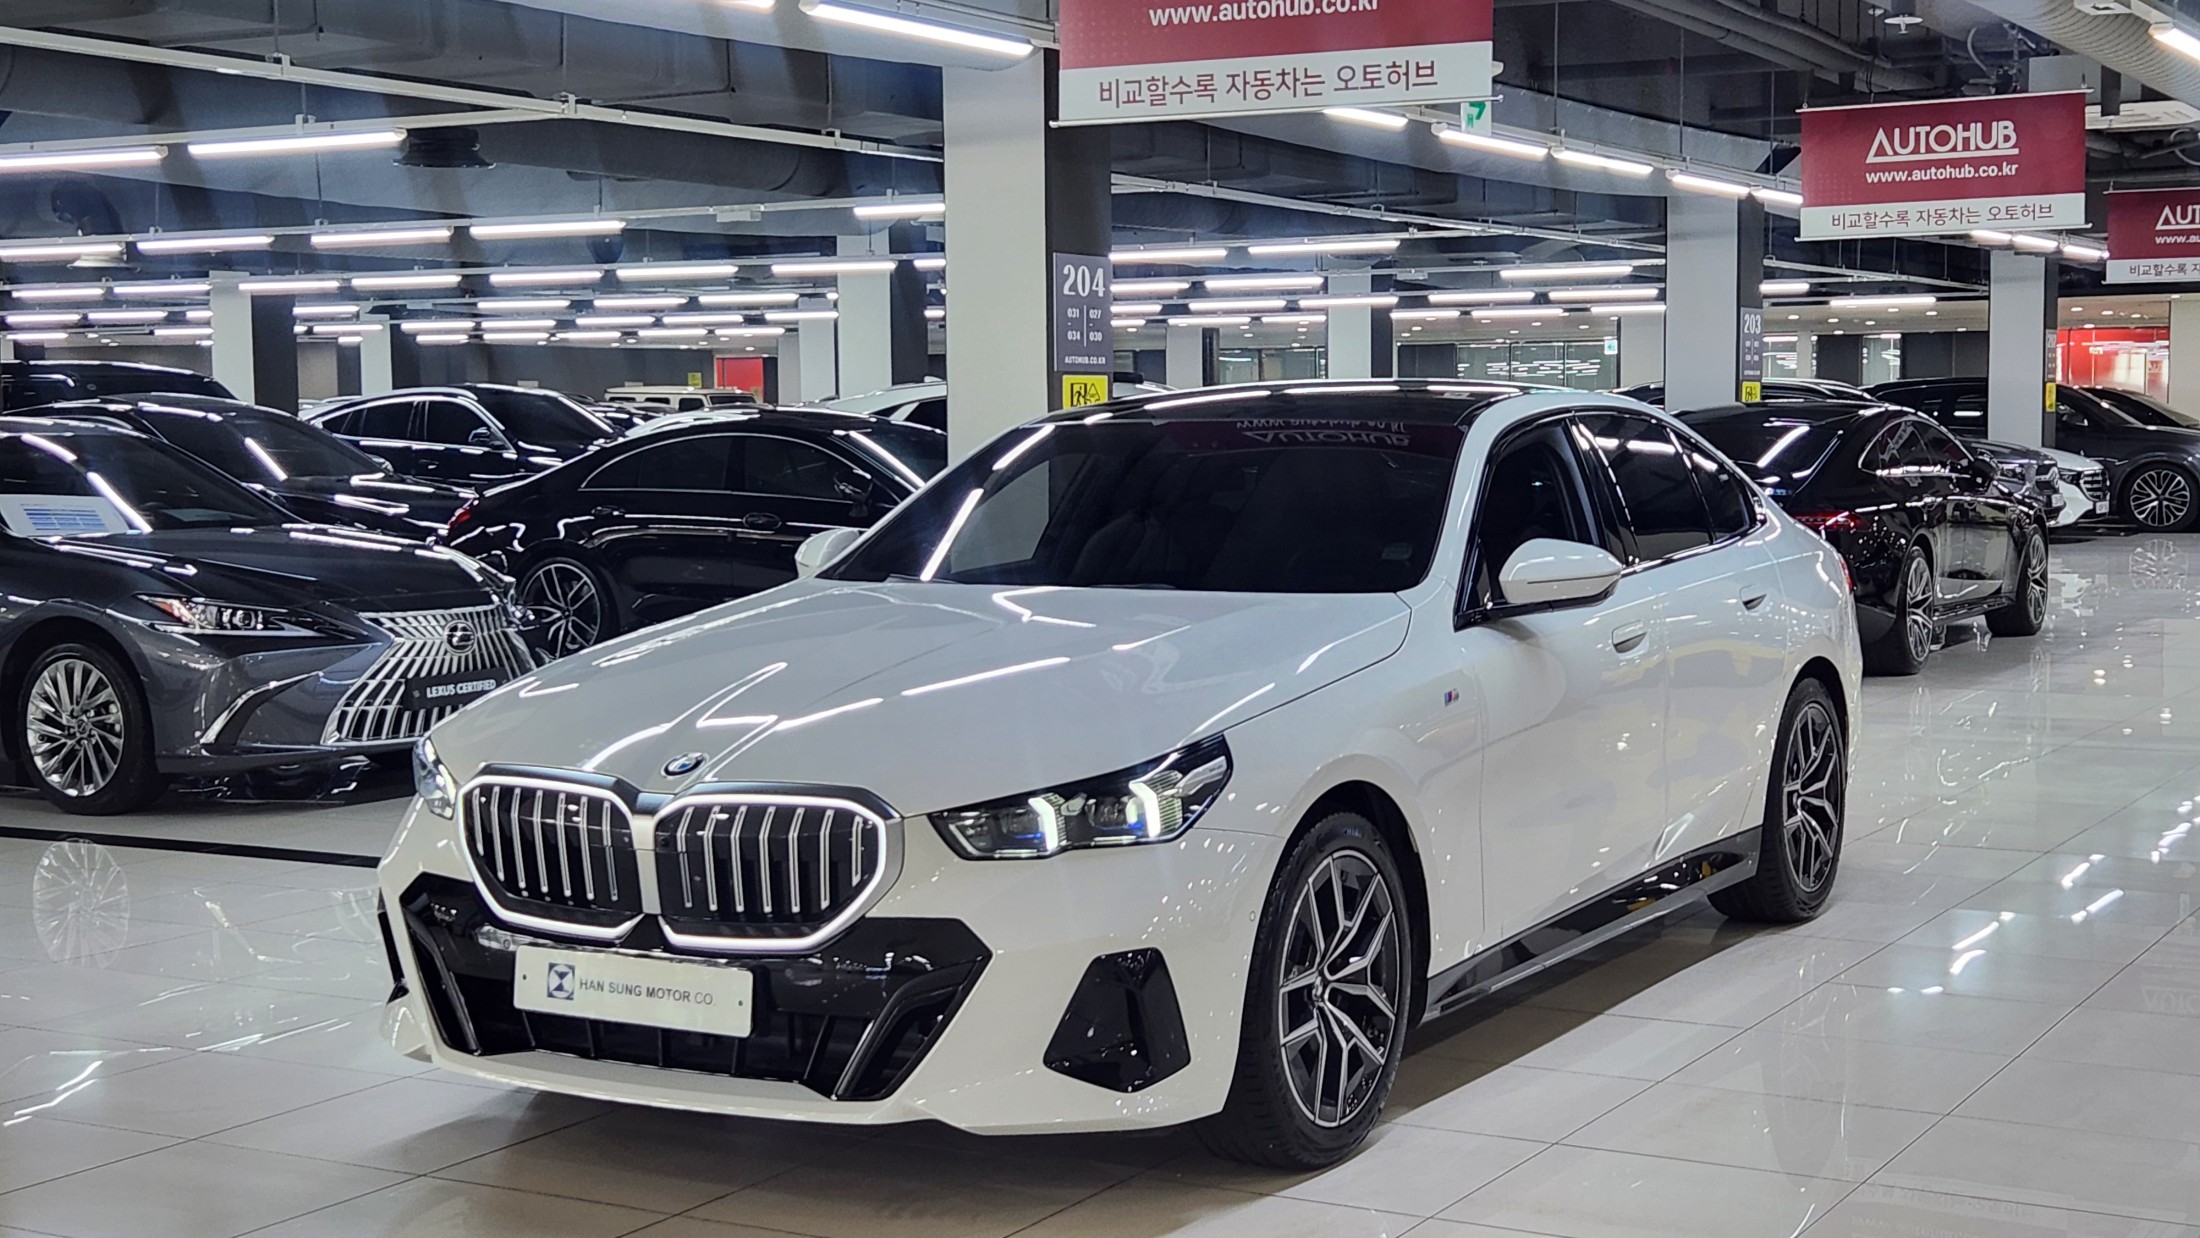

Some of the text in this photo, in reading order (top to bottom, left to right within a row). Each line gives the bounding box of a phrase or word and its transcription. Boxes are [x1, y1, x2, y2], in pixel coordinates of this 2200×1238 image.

[1099, 59, 1438, 109] 비교할수록 자동차는 오토허브
[1865, 120, 2019, 163] AUTOHUB
[1865, 161, 2019, 184] www.autohub.co.kr
[1831, 202, 2054, 230] 비교할수록 자동차는 오토허브
[2129, 263, 2188, 277] 비교할수록
[1062, 264, 1106, 298] 204
[1067, 307, 1080, 318] 031
[1089, 309, 1102, 319] 027
[1743, 313, 1761, 335] 203
[1067, 330, 1081, 341] 034
[1089, 331, 1103, 342] 030
[1064, 355, 1106, 365] AUTOHUB.CO.KR
[426, 679, 497, 698] LEXUS CERTIFIED
[579, 978, 605, 993] HAN
[608, 983, 642, 998] SUNG
[646, 987, 691, 1003] MOTOR
